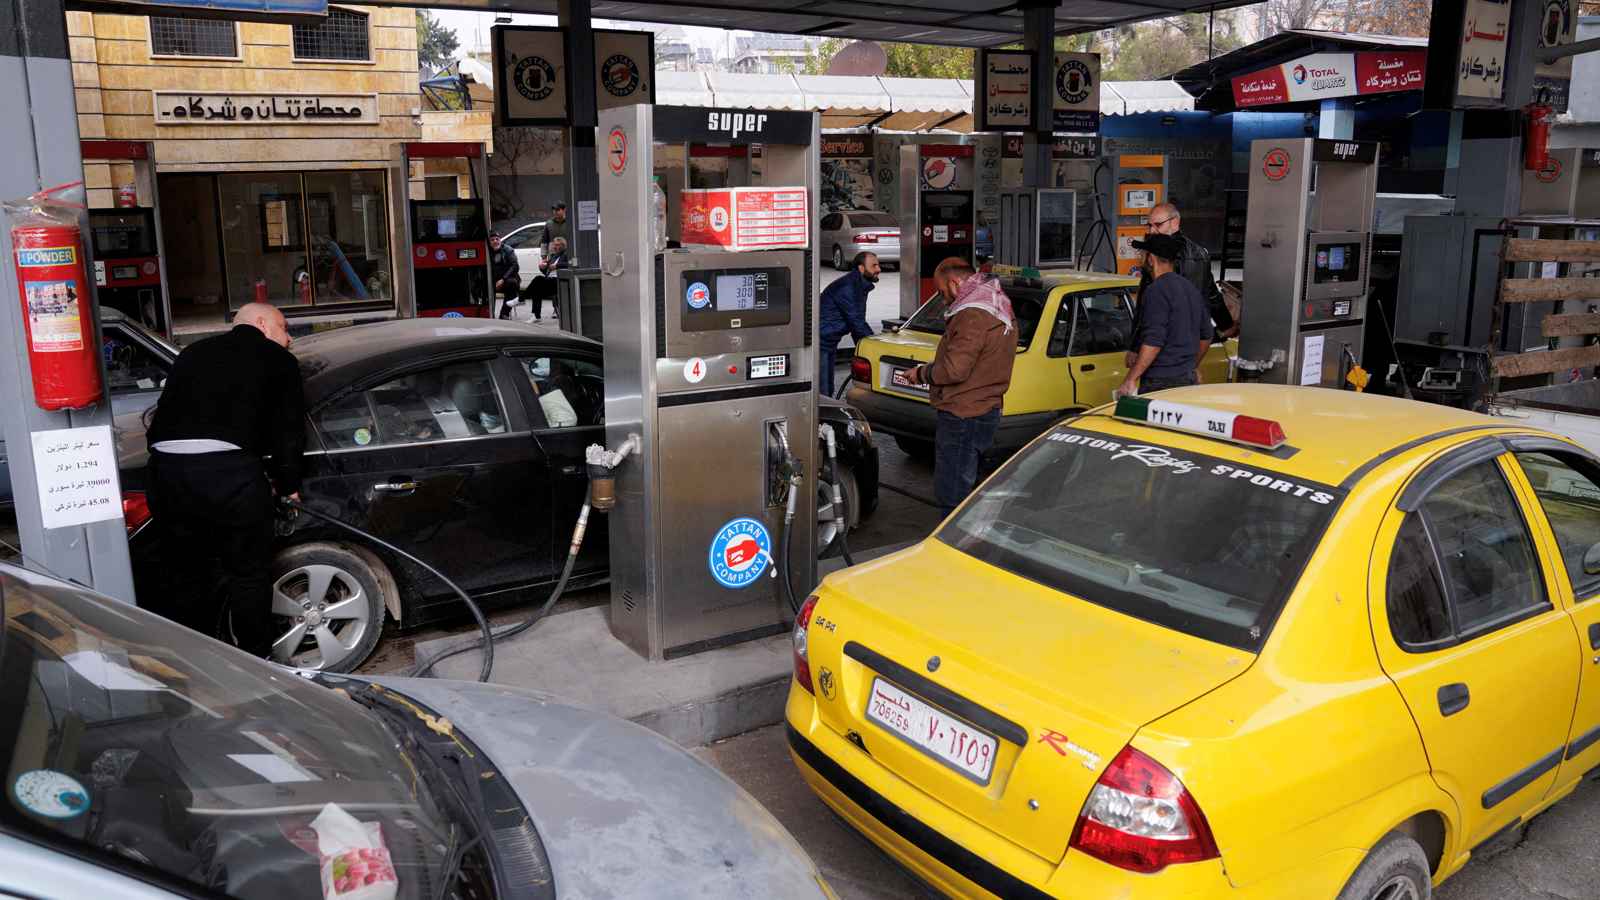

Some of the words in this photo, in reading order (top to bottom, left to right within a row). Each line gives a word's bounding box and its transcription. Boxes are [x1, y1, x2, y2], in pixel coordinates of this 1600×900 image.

[1311, 78, 1346, 91] QUARTZ
[257, 97, 301, 119] تتان
[303, 97, 363, 119] محطة
[708, 112, 768, 138] super
[1333, 143, 1359, 160] super
[26, 250, 73, 264] POWDER
[692, 362, 700, 377] 4
[1207, 420, 1226, 434] TAXI
[76, 460, 98, 470] 1.294
[1046, 432, 1124, 452] MOTOR
[1210, 464, 1335, 505] SPORTS
[88, 497, 110, 507] 45.08
[720, 522, 762, 542] TATTAN
[716, 558, 764, 583] COMPANY
[875, 688, 912, 712] حلب
[874, 700, 909, 731] 706259
[928, 716, 990, 773] ٧٠٦٢٥٩
